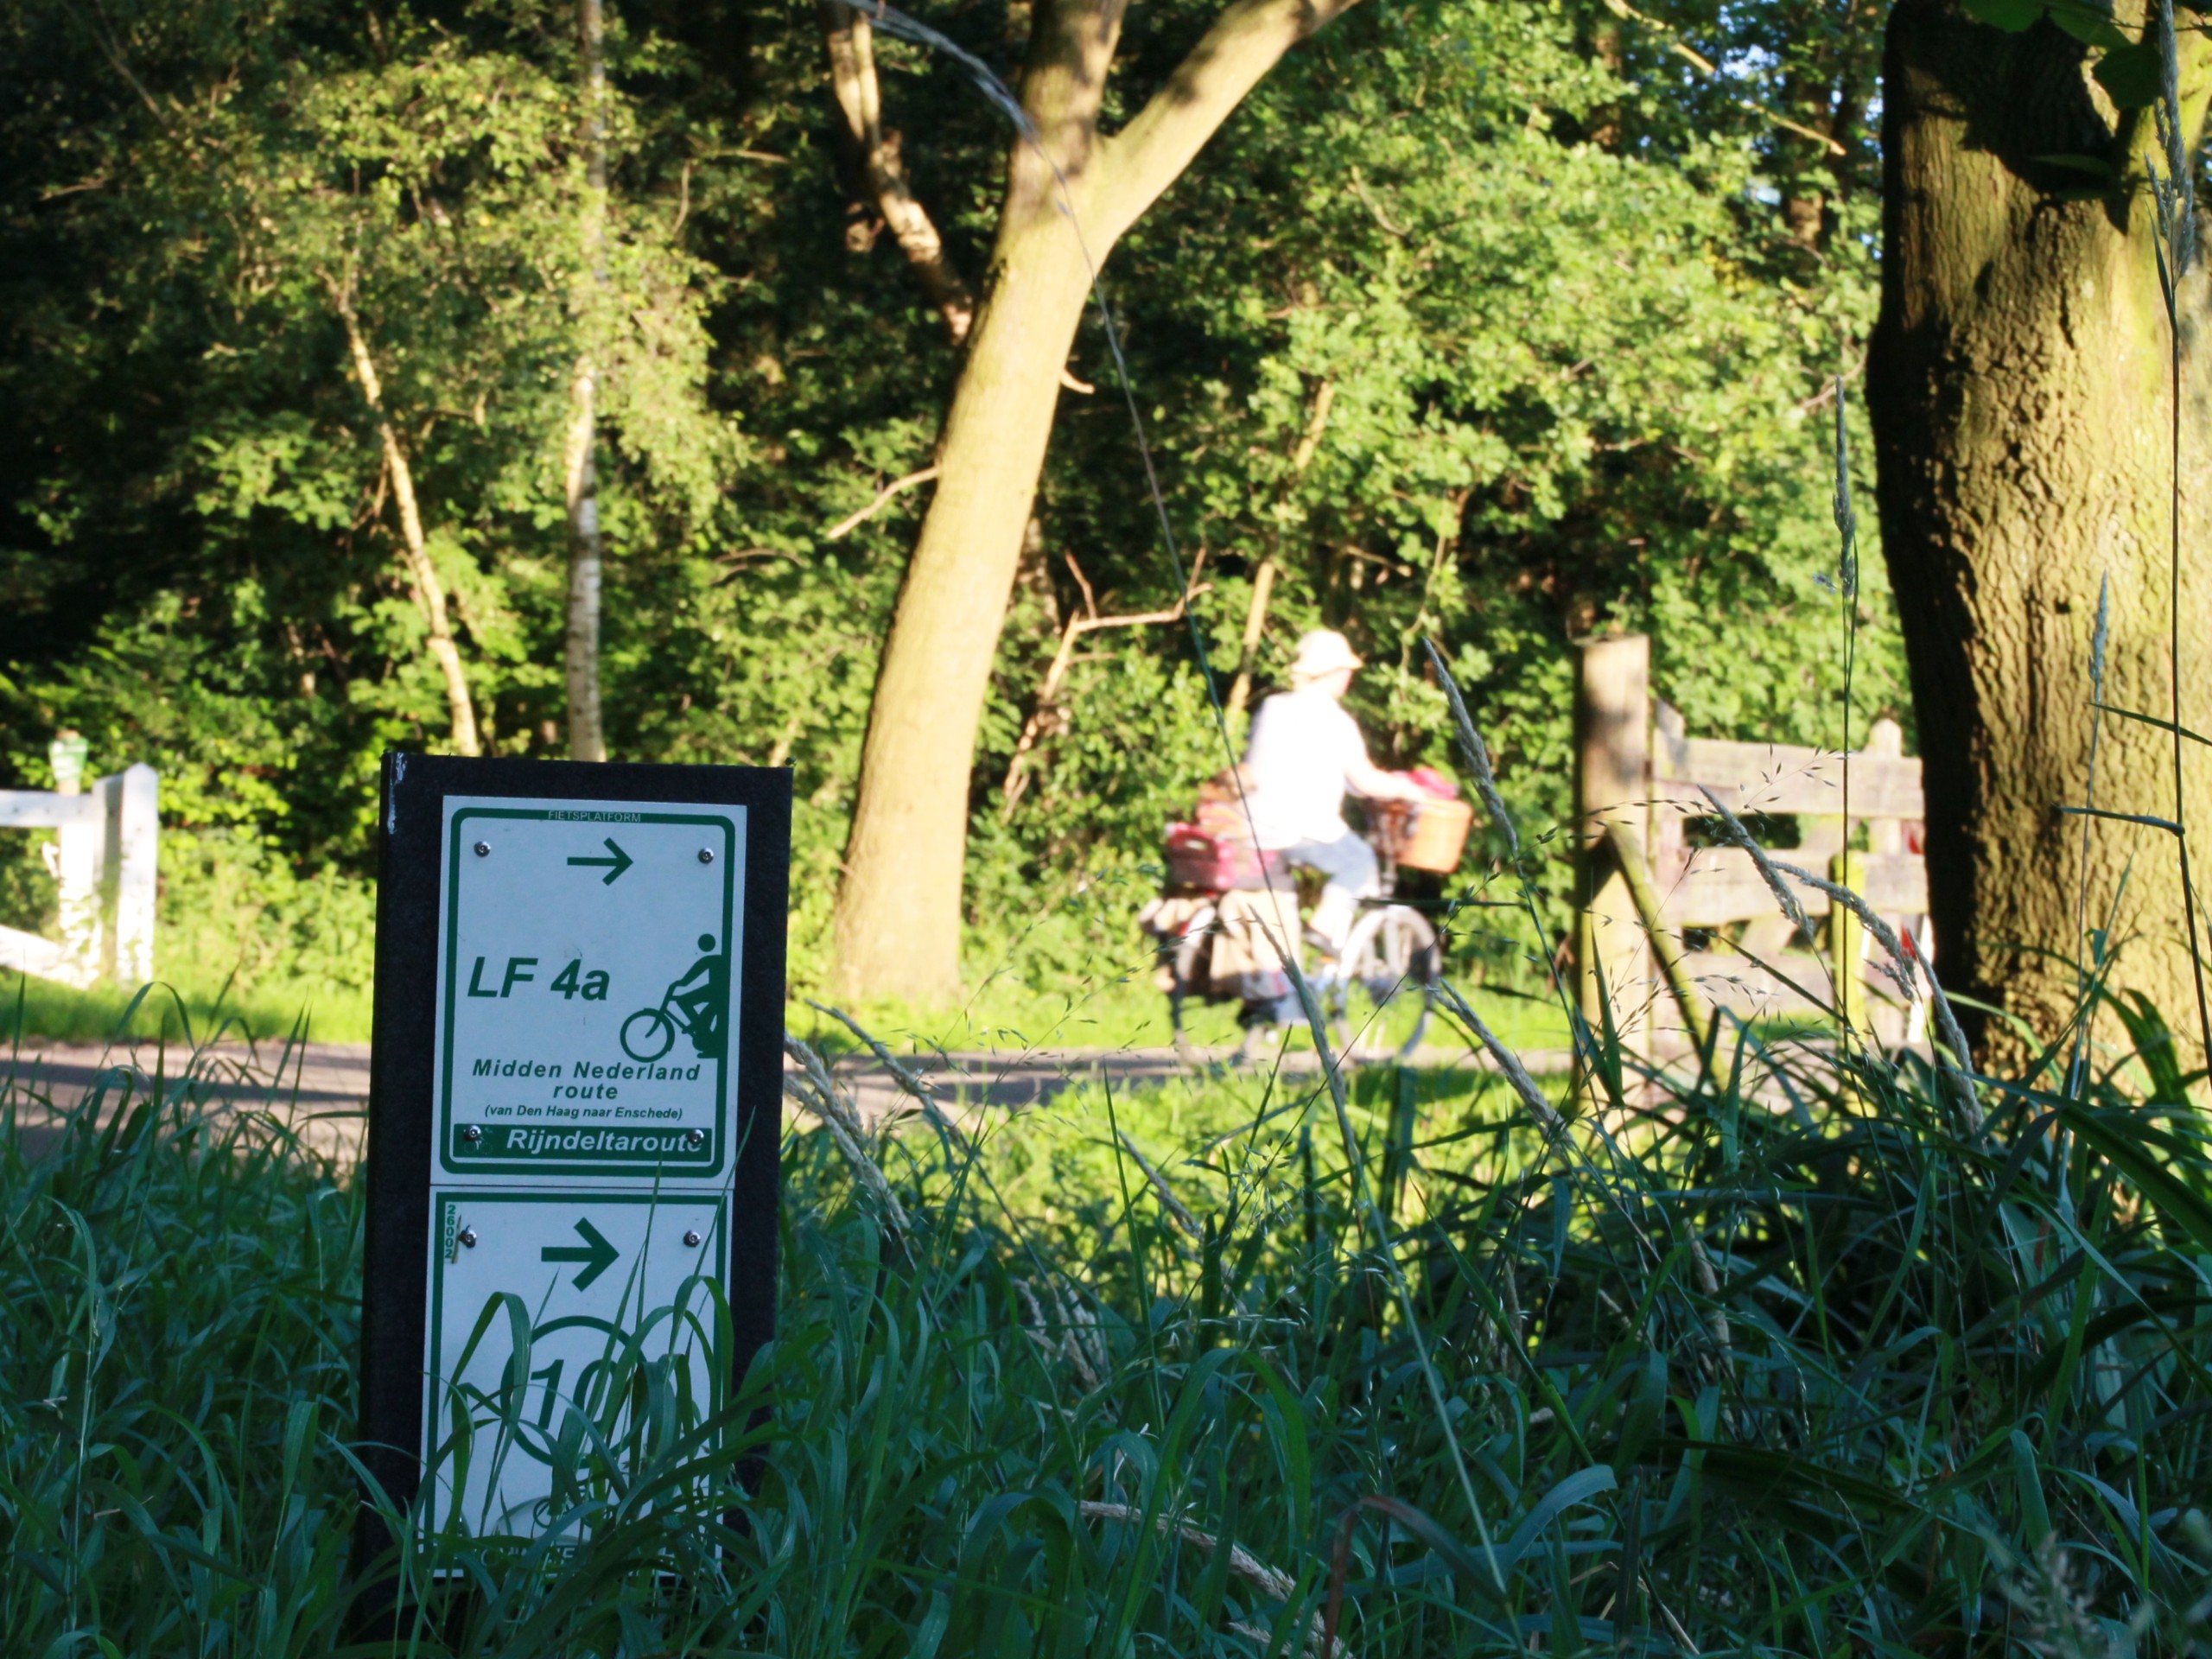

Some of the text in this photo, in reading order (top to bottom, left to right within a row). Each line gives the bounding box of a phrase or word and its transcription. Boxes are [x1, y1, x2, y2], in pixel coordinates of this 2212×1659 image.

[548, 810, 641, 823] FIETSPLATFORM
[467, 957, 610, 1001] LF 4a
[473, 1058, 701, 1081] Midden Nederland
[553, 1084, 618, 1099] route
[485, 1104, 683, 1122] (van Den Haag naar Enschede)
[445, 1205, 456, 1259] 26002
